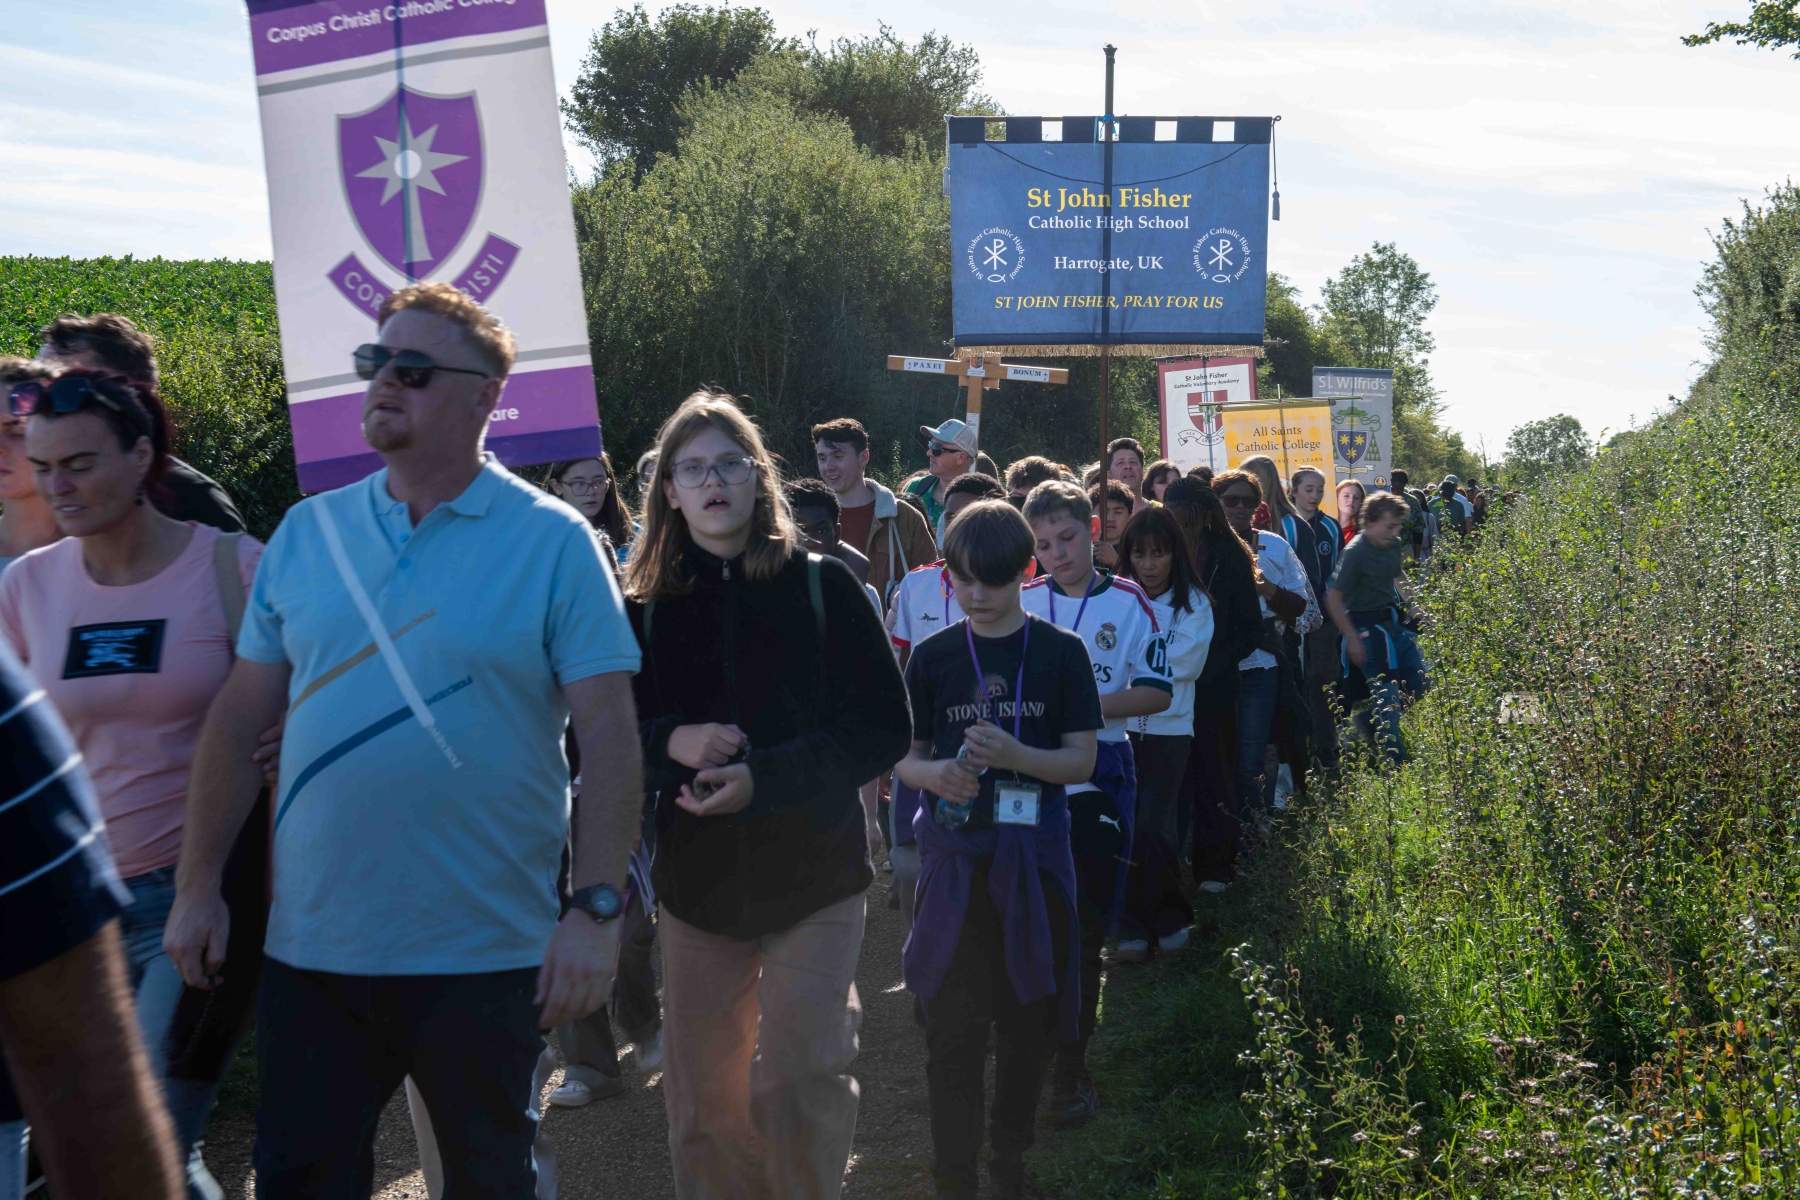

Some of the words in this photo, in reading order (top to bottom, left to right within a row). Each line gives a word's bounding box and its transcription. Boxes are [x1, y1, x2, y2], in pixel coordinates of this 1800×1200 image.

[266, 22, 327, 43] Corpus
[329, 9, 381, 32] Christi
[1027, 188, 1051, 207] St
[1057, 187, 1112, 213] John
[1119, 187, 1192, 208] Fisher
[983, 227, 1013, 239] Catholic
[1028, 215, 1092, 229] Catholic
[1096, 215, 1133, 233] High
[1138, 215, 1189, 229] School
[1209, 227, 1240, 239] Catholic
[967, 233, 983, 254] Fisher
[1012, 236, 1025, 255] High
[1192, 233, 1209, 254] Fisher
[1239, 236, 1251, 255] High
[968, 255, 979, 273] John
[1009, 256, 1026, 280] School
[1054, 256, 1133, 273] Harrogate,
[1138, 256, 1164, 270] UK
[1193, 254, 1204, 273] John
[1234, 256, 1251, 280] School
[344, 271, 386, 312] COR
[460, 253, 504, 300] RISTI
[976, 272, 984, 280] St
[1200, 271, 1209, 280] St
[995, 296, 1013, 309] ST
[1016, 296, 1060, 311] JOHN
[1063, 295, 1120, 310] FISHER,
[1123, 295, 1163, 308] PRAY
[1166, 296, 1198, 308] FOR
[1202, 296, 1224, 309] US
[1013, 368, 1042, 377] BONUM
[490, 407, 519, 421] are
[1253, 426, 1268, 437] All
[1270, 426, 1302, 436] Saints
[1236, 441, 1280, 453] Catholic
[1282, 439, 1321, 451] College
[1093, 662, 1113, 683] es
[946, 703, 992, 723] STONE
